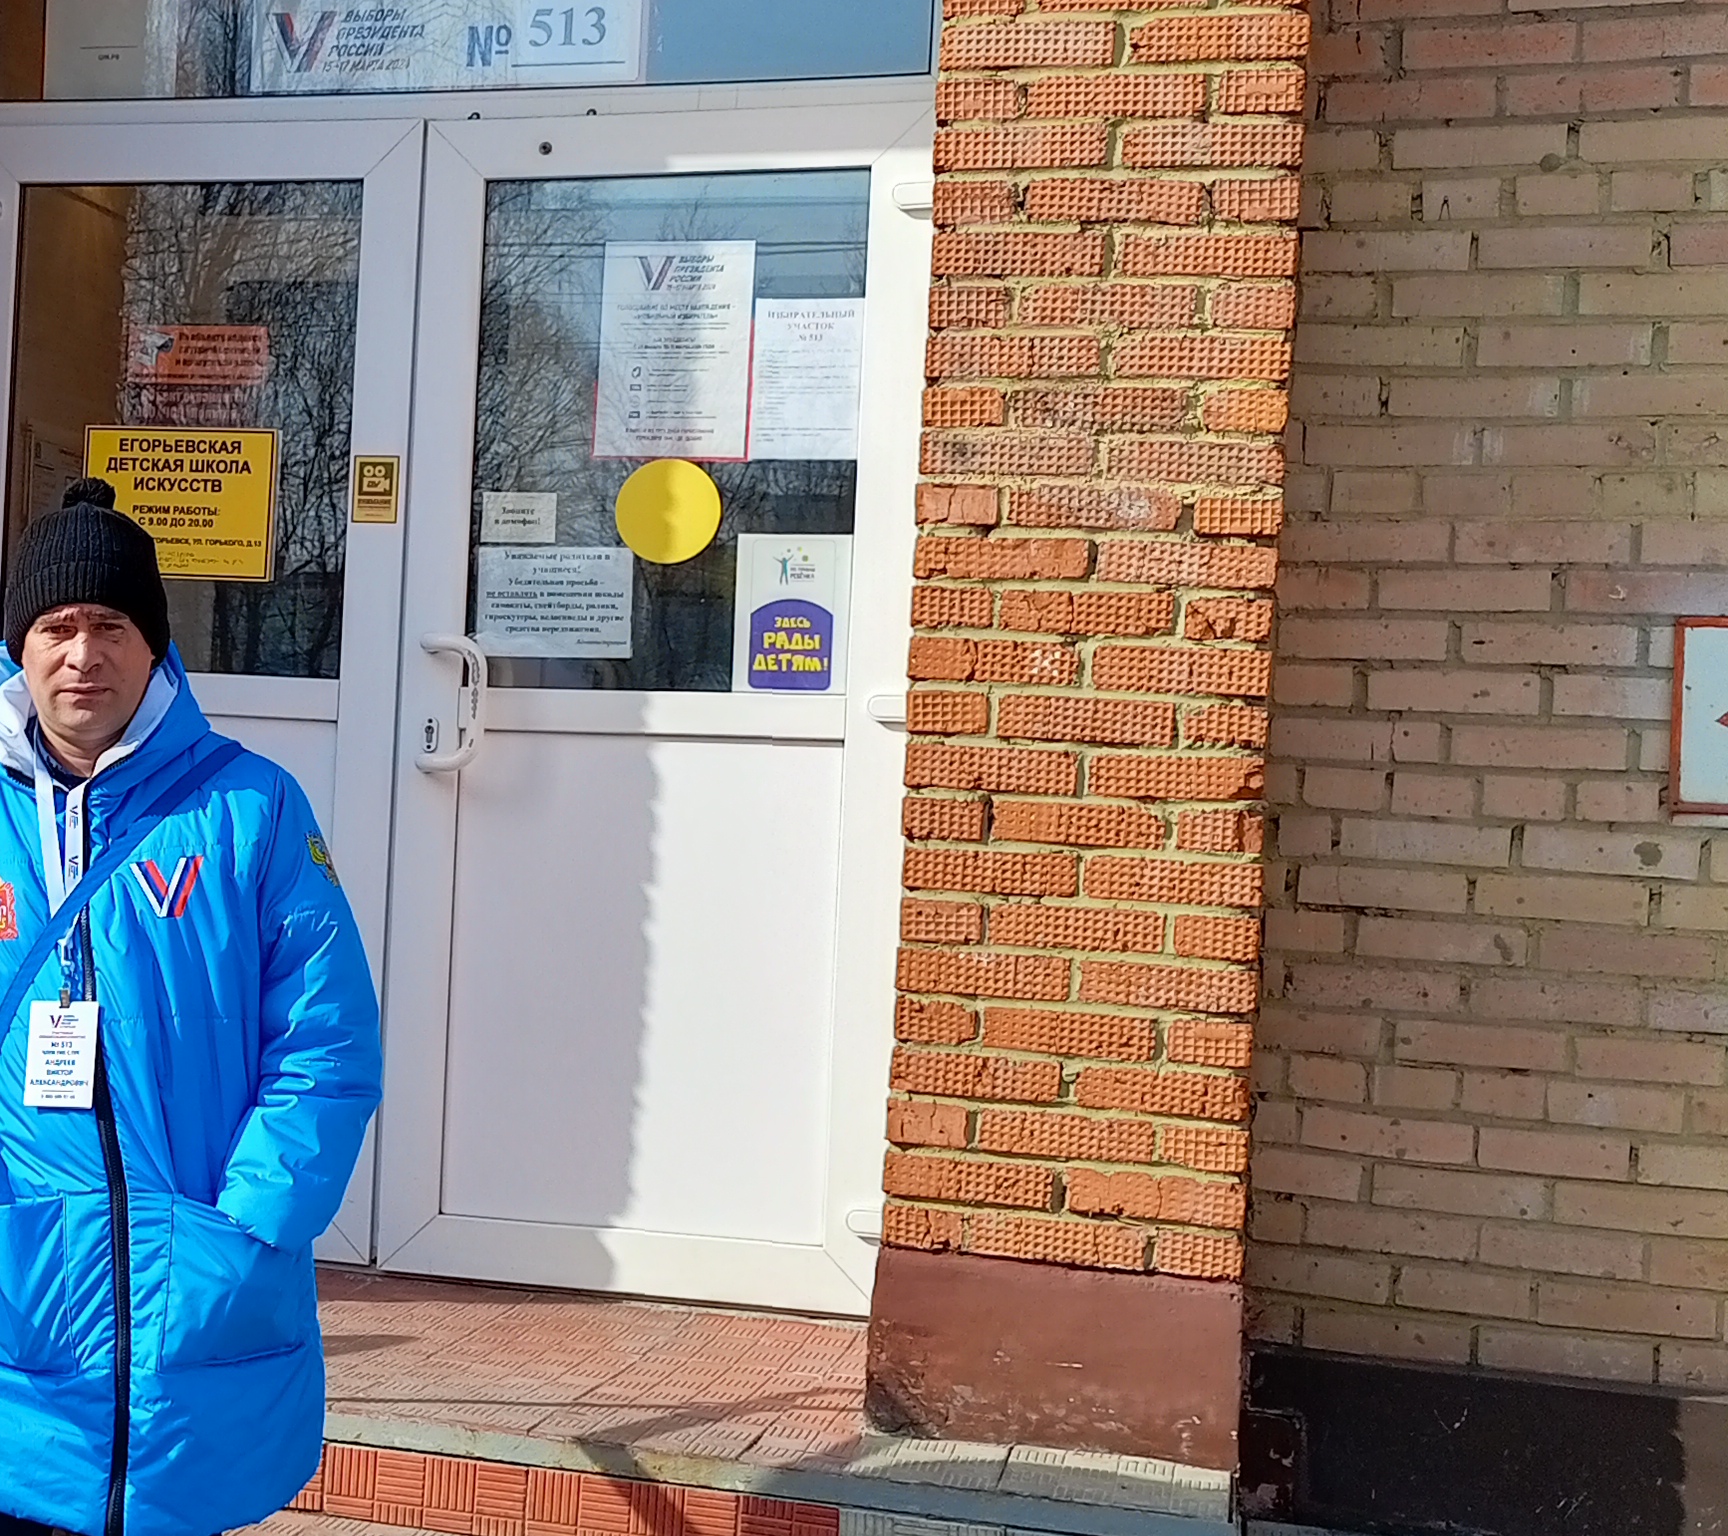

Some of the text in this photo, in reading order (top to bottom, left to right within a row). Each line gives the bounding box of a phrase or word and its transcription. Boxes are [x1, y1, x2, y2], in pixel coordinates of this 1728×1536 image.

[340, 9, 408, 23] ВЫБОРЫ
[335, 24, 425, 40] ПРЕЗИДЕНТА
[465, 6, 607, 68] № 513
[327, 42, 386, 57] РОССИИ
[767, 309, 855, 319] ИЗБИРАТЕЛЬНЫЙ
[787, 322, 835, 330] УЧАСТОК
[809, 333, 823, 341] 513
[118, 438, 242, 454] ЕГОРЬЕВСКАЯ
[105, 457, 252, 474] ДЕТСКАЯ ШКОЛА
[133, 476, 223, 493] ИСКУССТВ
[132, 505, 221, 516] РЕЖИМ РАБОТЫ:
[501, 506, 535, 515] Звоните
[138, 517, 214, 529] С 9.00 ДО 20.00
[501, 517, 541, 527] домофон!
[504, 551, 558, 561] Уважаемые
[559, 552, 603, 562] родители
[508, 577, 598, 588] Убедительная просьба
[491, 602, 533, 610] самокаты,
[595, 615, 624, 623] другие
[774, 616, 811, 629] ЗДЕСЬ
[505, 626, 540, 634] средства
[762, 631, 821, 650] РАДЫ
[752, 653, 829, 672] ДЕТЯМ!
